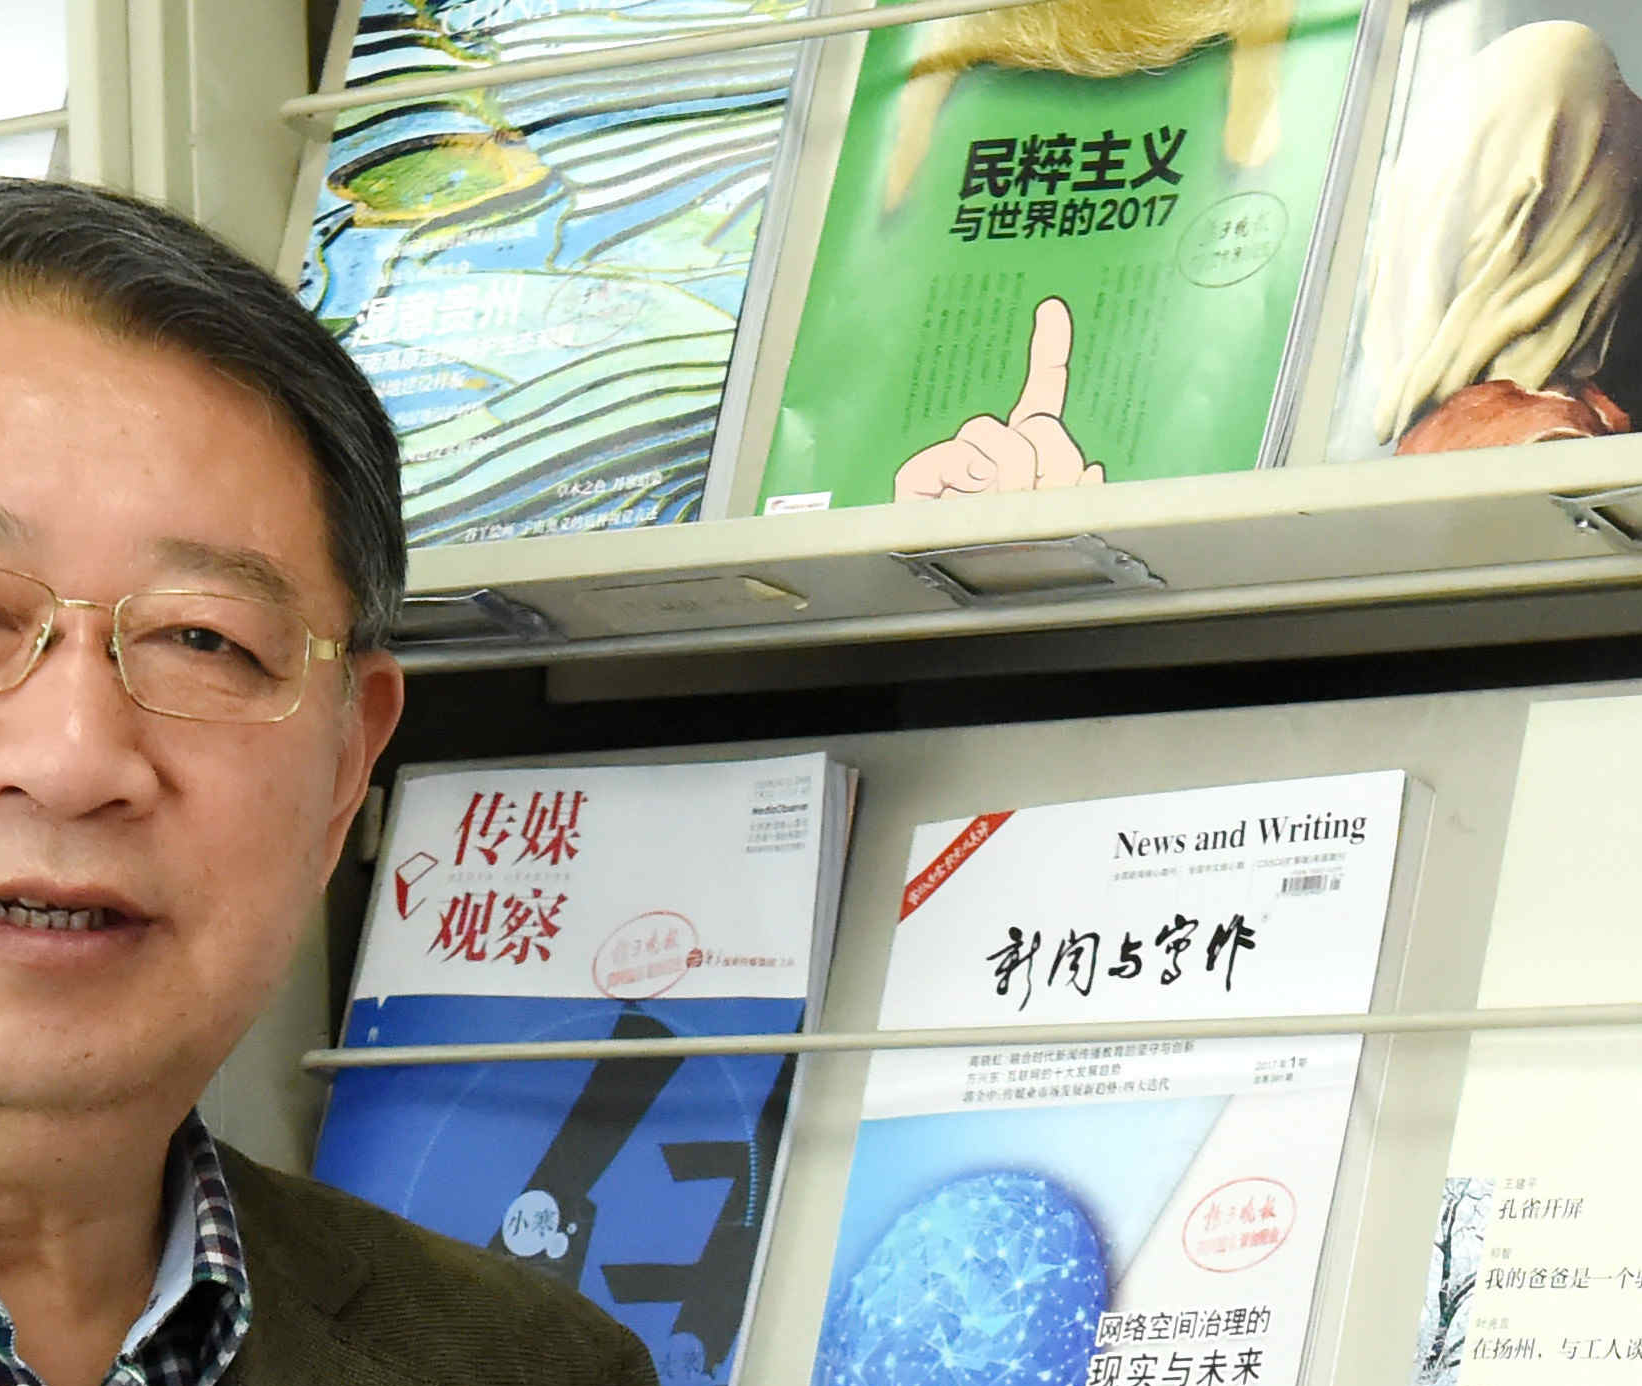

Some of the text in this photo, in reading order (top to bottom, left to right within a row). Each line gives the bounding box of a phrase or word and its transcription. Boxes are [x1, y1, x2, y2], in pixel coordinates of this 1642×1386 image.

[959, 126, 1188, 198] 民粹主义
[949, 194, 1177, 242] 与世界的2017
[453, 790, 590, 867] 传媒
[1113, 811, 1367, 860] News and Writing
[429, 889, 569, 966] 观察
[507, 1206, 557, 1239] 小寒
[1498, 1196, 1585, 1221] 孔雀开屏
[1097, 1304, 1272, 1346] 网络空间治理的
